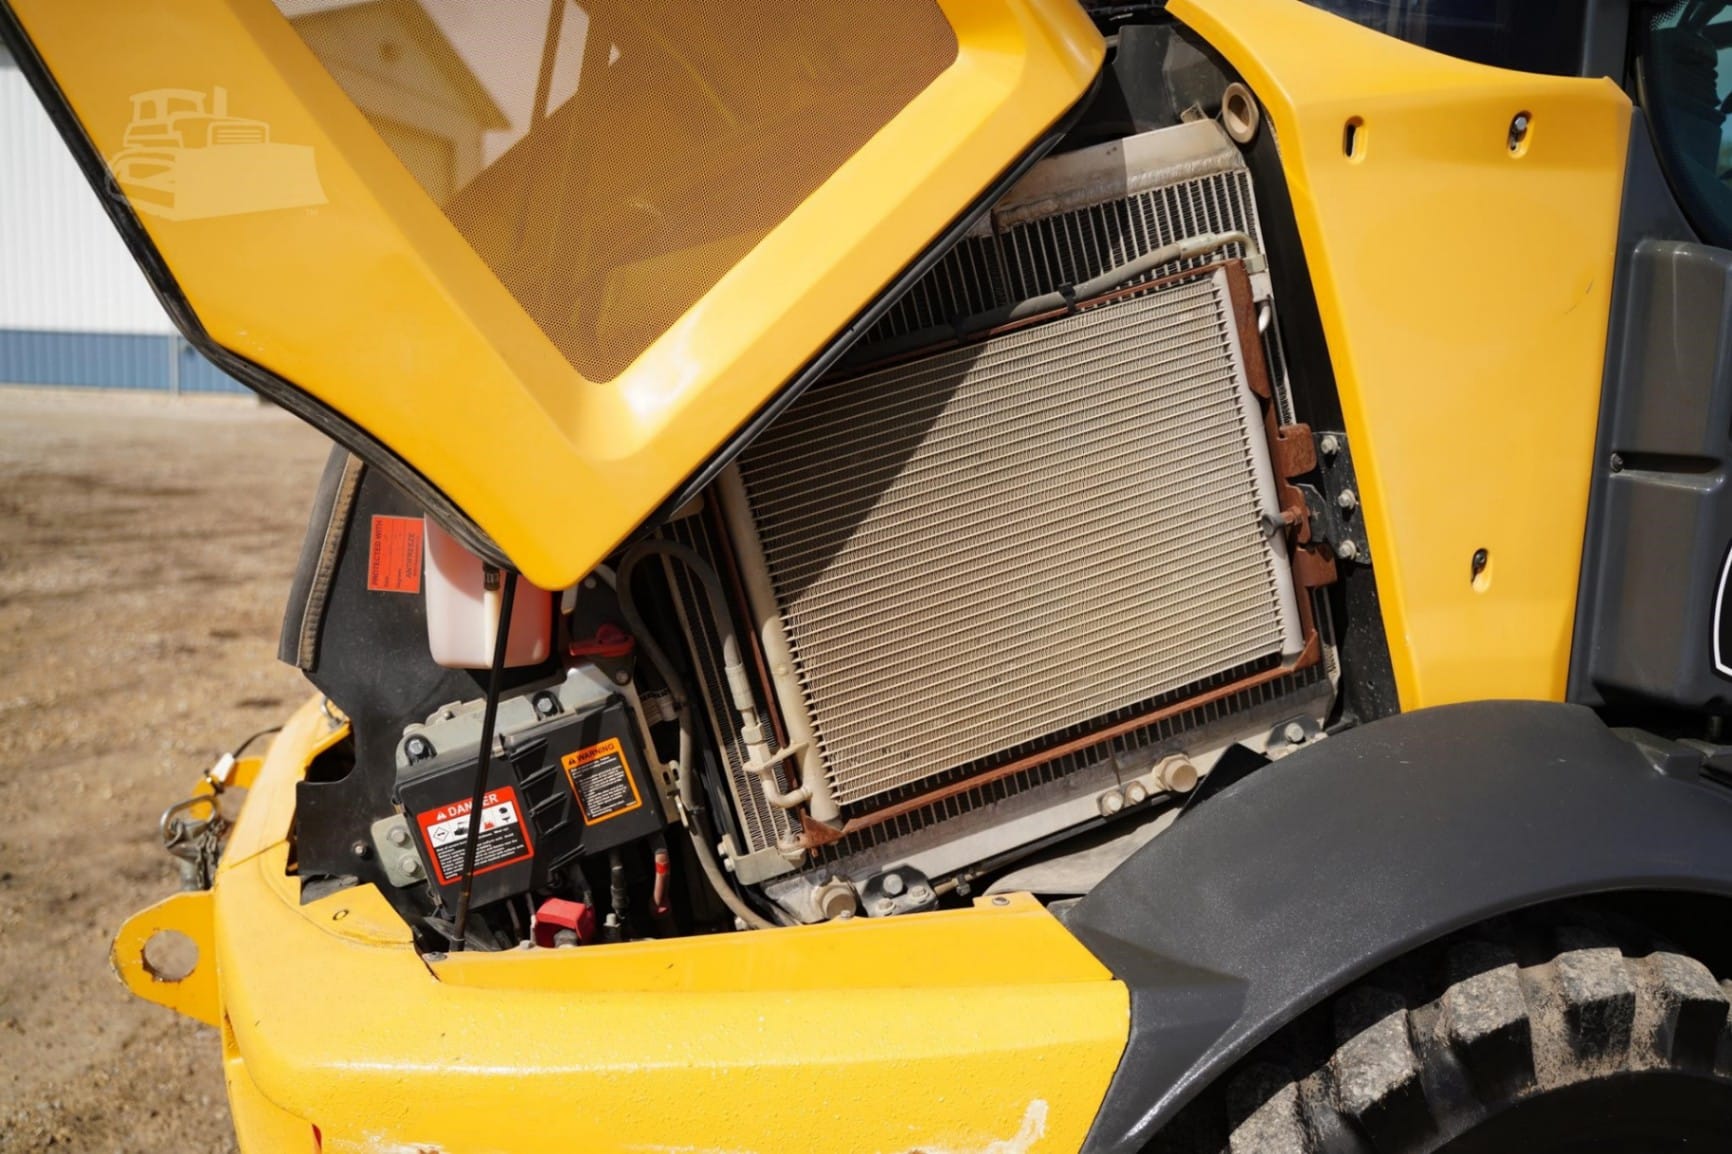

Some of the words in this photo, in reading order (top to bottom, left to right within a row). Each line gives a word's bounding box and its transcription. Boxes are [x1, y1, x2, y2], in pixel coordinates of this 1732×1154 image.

[375, 520, 384, 539] WITH
[372, 541, 381, 586] PROTECTED
[576, 743, 614, 761] WARNING
[448, 793, 499, 817] DANER
